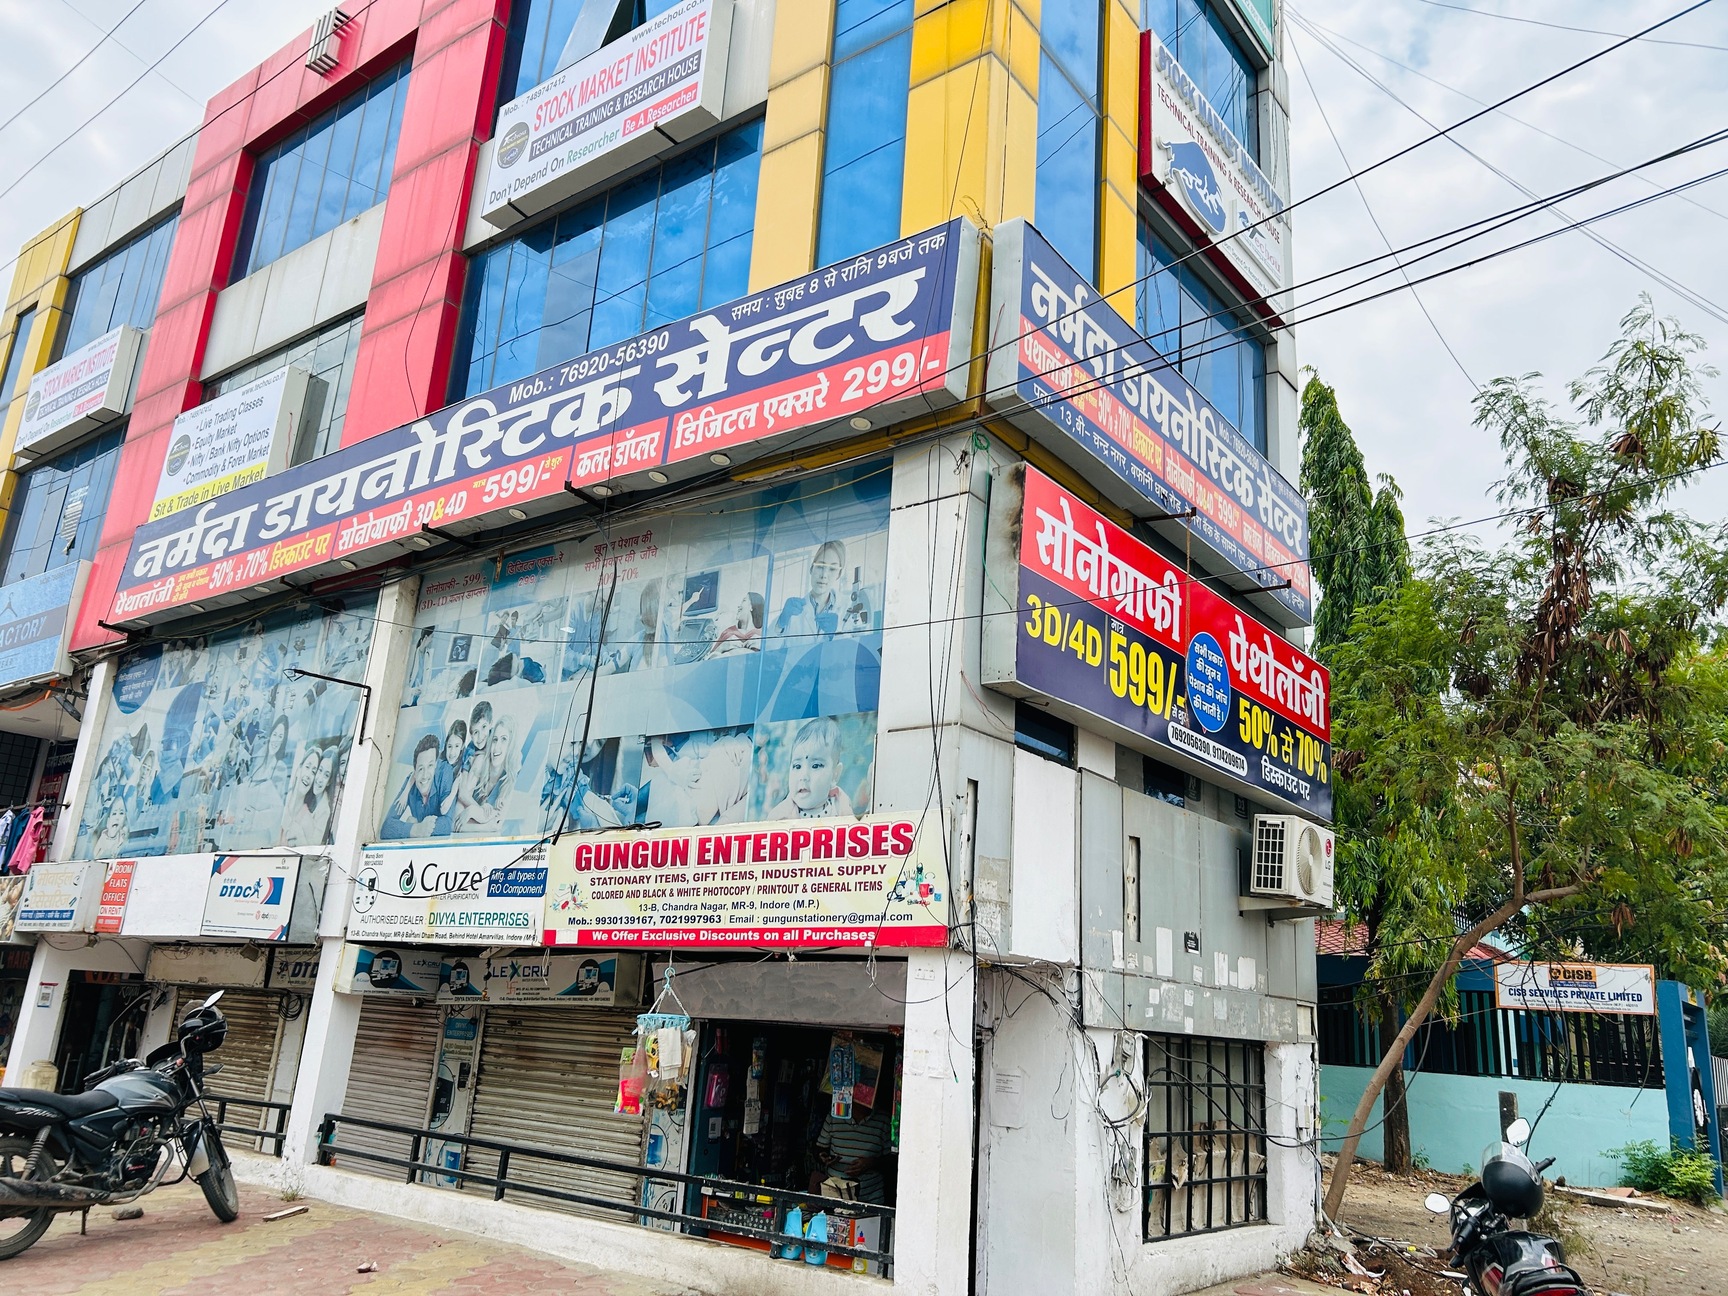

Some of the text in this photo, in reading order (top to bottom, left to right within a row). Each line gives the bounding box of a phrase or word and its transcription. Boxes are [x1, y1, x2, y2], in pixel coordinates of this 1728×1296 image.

[534, 12, 706, 131] STOCK MARKET INSTITUTE
[532, 56, 698, 156] TECHNICAL TRAINING & RESEARCH HOUSE
[489, 88, 696, 204] Don't Depend On Researcher Be A Researcher
[1157, 45, 1196, 109] STOCK
[1240, 148, 1283, 222] INSTITUTE
[1157, 83, 1194, 140] TECHNICAL
[1197, 132, 1227, 177] TRAINING
[1234, 178, 1262, 222] RESEARCH
[731, 232, 947, 321] समय सुबह 8 से तक
[559, 331, 669, 386] 76920-56390
[674, 405, 759, 450] डिजिटल
[840, 346, 940, 403] 299/-
[1030, 261, 1118, 390] नर्मदा
[1256, 463, 1303, 556] सेन्टर
[133, 501, 258, 578] नर्मदा
[653, 267, 926, 407] सेन्टर
[200, 416, 212, 431] Live
[214, 407, 237, 426] Trading
[238, 397, 264, 415] Classes
[1059, 406, 1072, 425] 13
[195, 423, 238, 450] Equity Market
[209, 446, 224, 460] Bank
[243, 428, 269, 447] Options
[186, 444, 270, 486] Commodity Forex Market
[576, 446, 612, 478] कलर
[154, 468, 264, 518] Sit & Trade in Live Market
[482, 460, 551, 503] 599/-
[618, 531, 653, 550] पेशाब की
[209, 558, 236, 589] 50%
[242, 547, 270, 579] 70%
[315, 533, 332, 556] पर
[1036, 495, 1182, 643] सोनोग्राफी
[1024, 593, 1103, 668] 3D/4D
[1110, 618, 1124, 634] मात्र
[1194, 642, 1223, 668] सभी प्रकार
[1196, 658, 1205, 675] की
[1193, 695, 1201, 711] की
[1239, 697, 1327, 784] 50% से 70%
[1261, 755, 1310, 801] डिस्काउंट पर
[574, 822, 916, 873] GUNGUN ENTERPRISES
[114, 864, 132, 873] ROOM
[421, 862, 482, 892] Cruze
[508, 870, 546, 882] all types of
[590, 863, 886, 887] STATIONARY ITEMS, GIFT ITEMS, INDUSTRIAL SUPPLY
[109, 879, 127, 887] FLATS
[219, 885, 251, 897] DTDC
[489, 884, 543, 895] RO Component
[591, 880, 882, 900] COLORED AND BLACK & WHITE PHOTOCOPY PRINTOUT & GENERAL ITEMS
[103, 893, 126, 901] OFFICE
[638, 898, 820, 913] 13-B, Chandra Nagar, MR-9, Indore (M.P.)
[360, 912, 529, 927] AUTHORISED DEALER DIVYA ENTERPRISES
[568, 911, 913, 927] Mob.: 9930139167, 7021997963 Email gungunstationery@gmail.com
[506, 933, 522, 941] Indore
[592, 929, 876, 941] We Offer Exclusive Discounts on all Purchases
[7, 951, 30, 969] HAIR
[290, 962, 319, 978] DTD
[1563, 969, 1593, 980] CISB
[1508, 988, 1642, 1002] CISB SERVICES PRIVATE LIMITED
